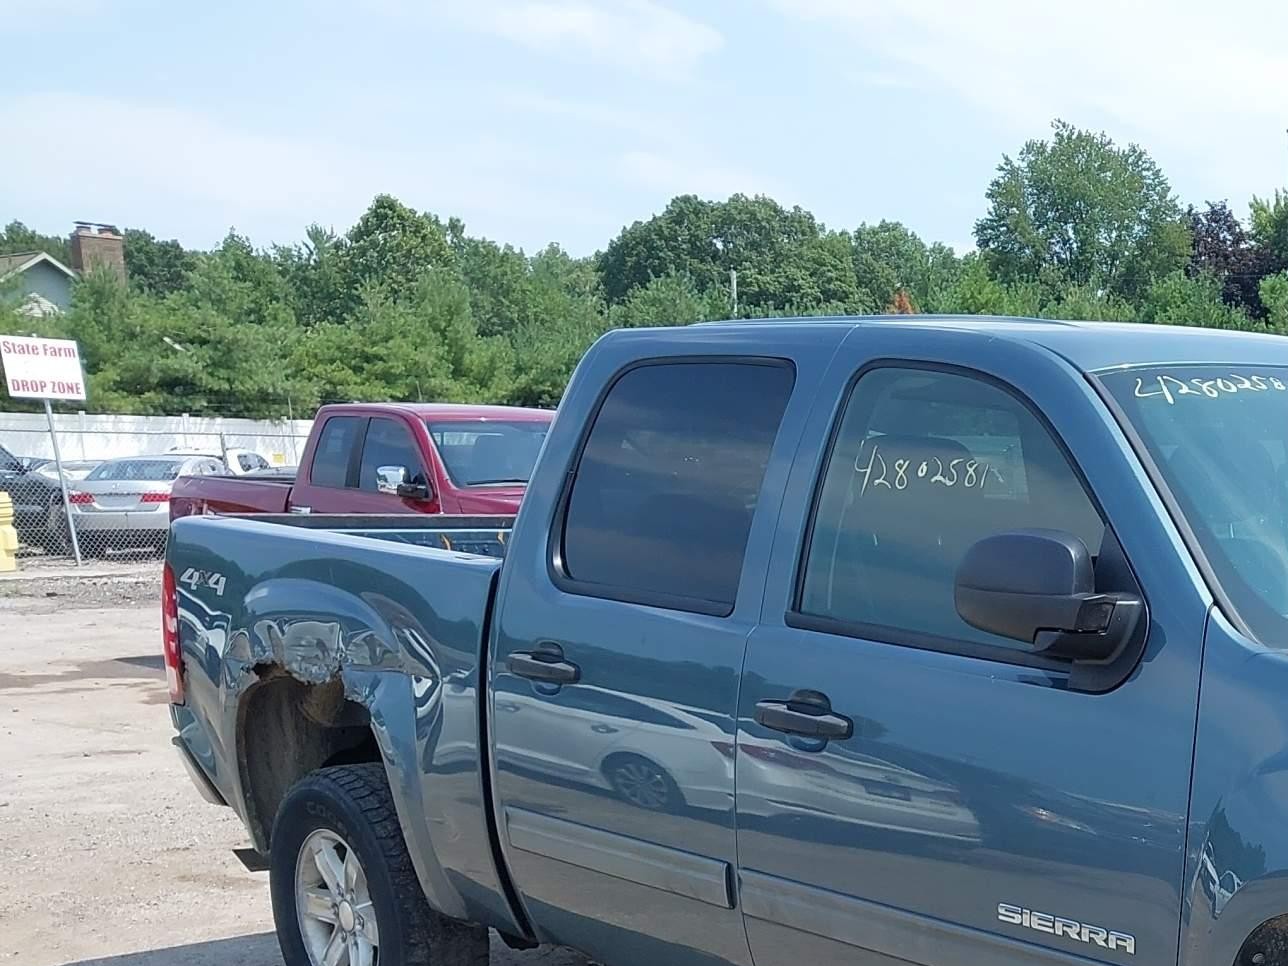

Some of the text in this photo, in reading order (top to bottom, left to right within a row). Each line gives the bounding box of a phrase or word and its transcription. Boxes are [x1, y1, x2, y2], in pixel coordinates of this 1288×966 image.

[2, 340, 76, 358] State Farm
[11, 379, 81, 395] DROP ZONE
[997, 903, 1136, 956] SIERRA
